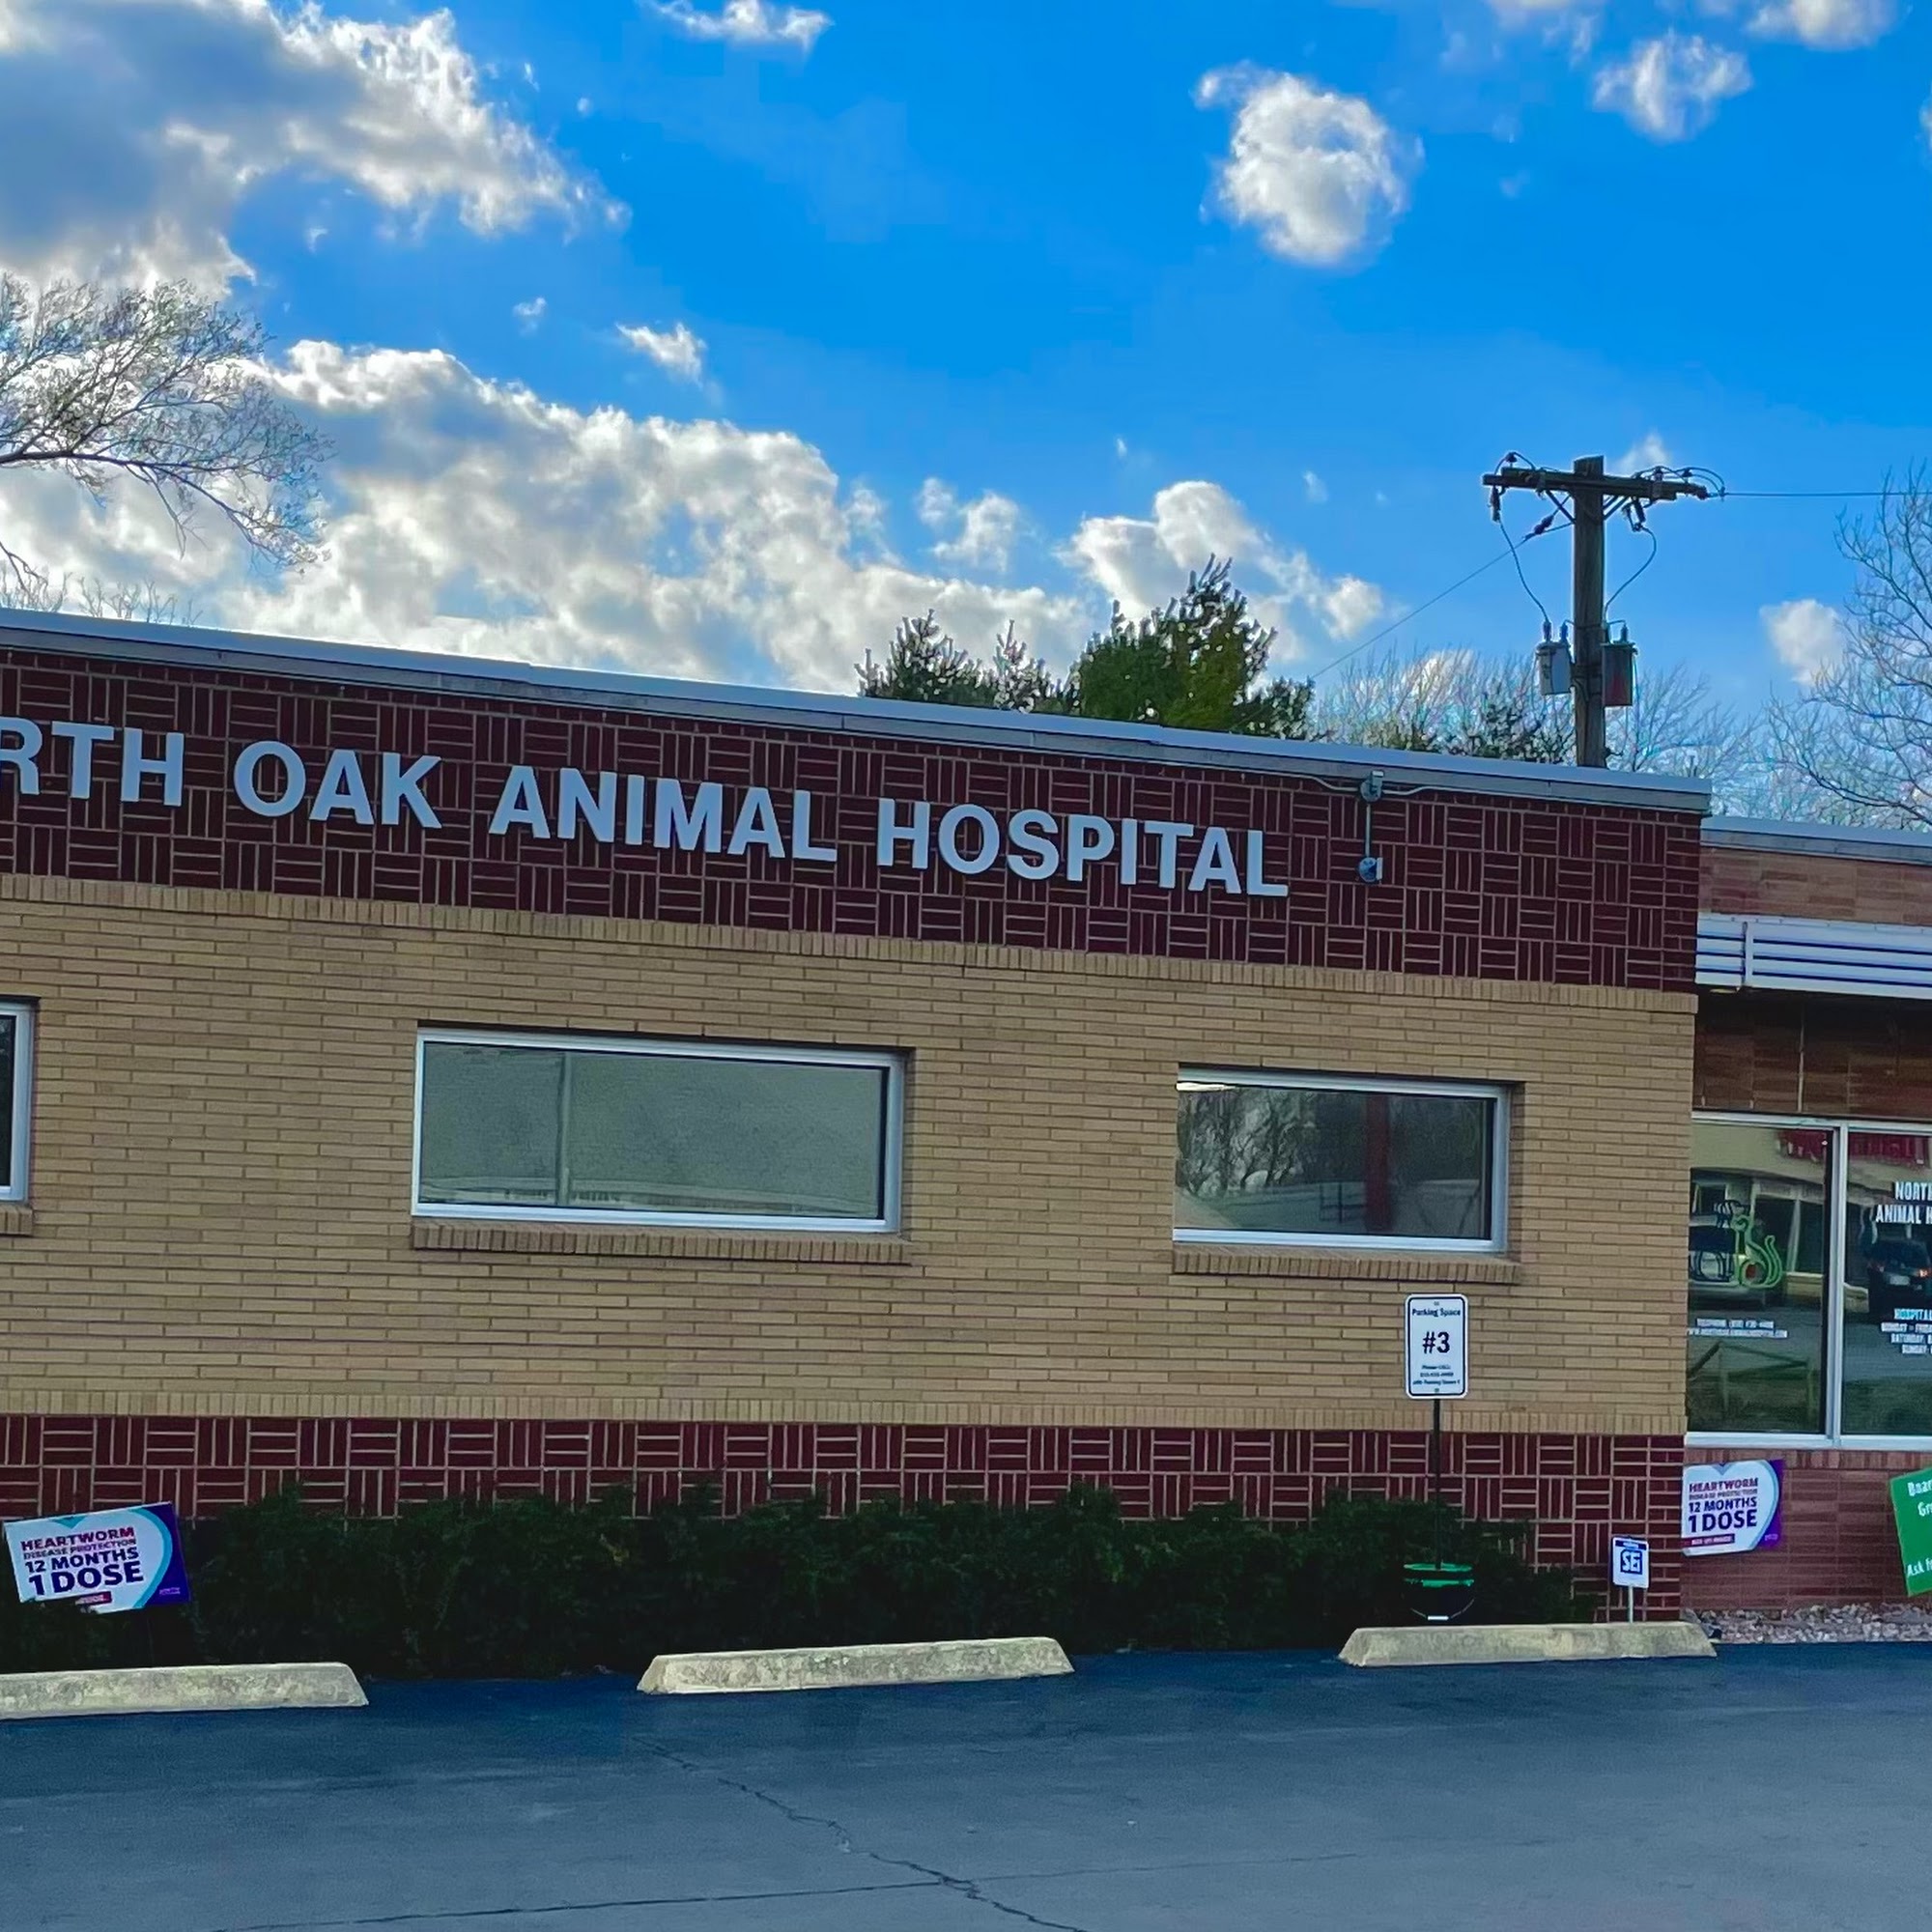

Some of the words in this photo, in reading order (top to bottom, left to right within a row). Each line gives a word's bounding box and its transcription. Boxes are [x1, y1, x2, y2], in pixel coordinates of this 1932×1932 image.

[0, 716, 185, 807] RTH
[234, 741, 441, 829] OAK
[488, 766, 837, 862] ANIMAL
[877, 798, 1288, 896] HOSPITAL
[1875, 1204, 1921, 1224] ANIMAL
[1412, 1308, 1438, 1318] Parking
[1440, 1307, 1461, 1318] Space
[1423, 1331, 1450, 1354] #3
[1689, 1477, 1759, 1492] HEARTWORM
[1689, 1501, 1701, 1514] 12
[1704, 1496, 1757, 1512] MONTHS
[1688, 1514, 1697, 1533] 1
[1702, 1509, 1757, 1531] DOSE
[20, 1526, 135, 1551] HEARTWORM
[23, 1547, 70, 1560] DISEASE
[71, 1538, 137, 1554] PROTECTION
[25, 1559, 46, 1574] 12
[51, 1547, 139, 1570] MONTHS
[29, 1574, 45, 1596] 1
[51, 1560, 144, 1593] DOSE
